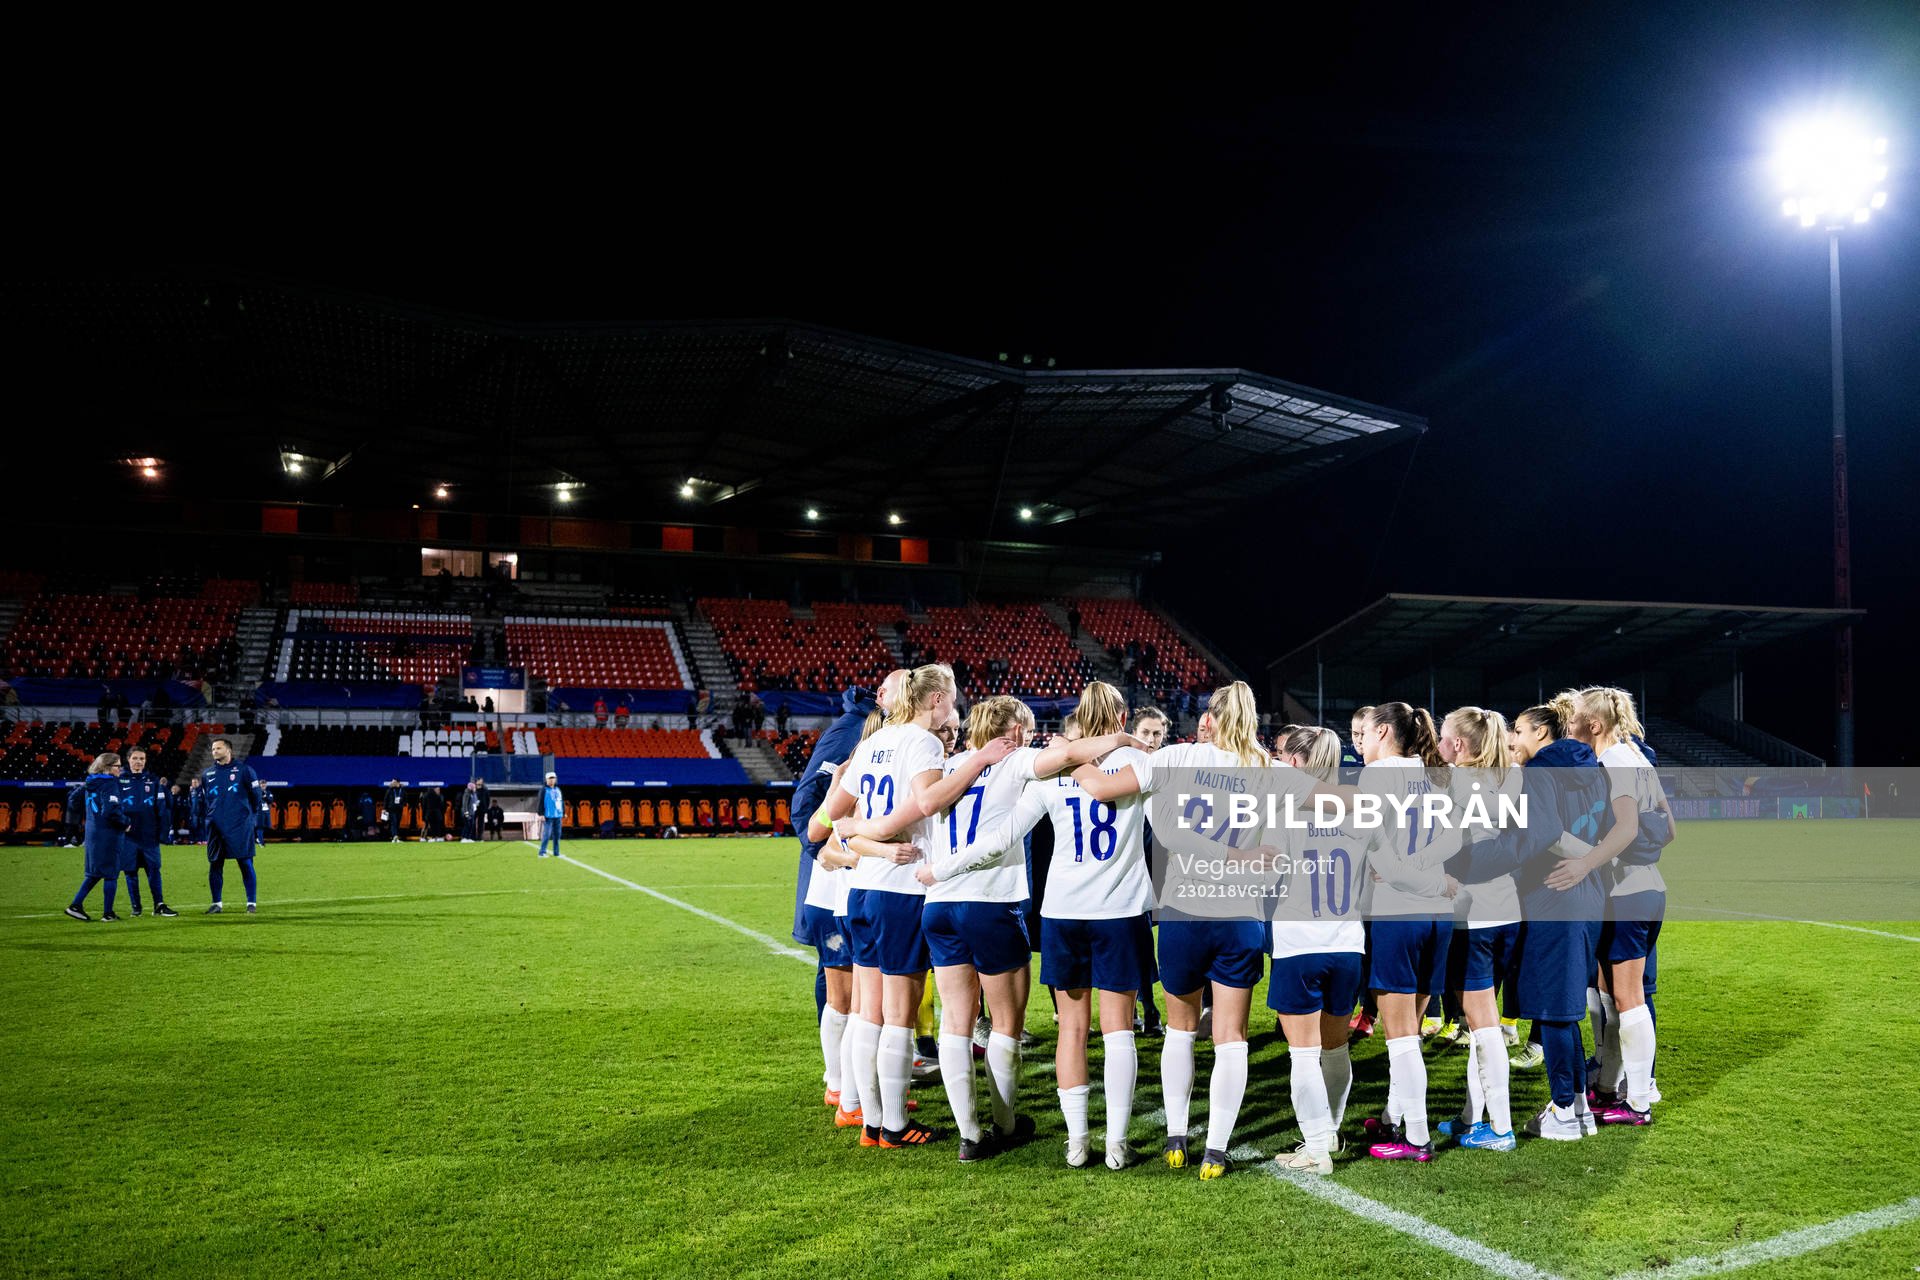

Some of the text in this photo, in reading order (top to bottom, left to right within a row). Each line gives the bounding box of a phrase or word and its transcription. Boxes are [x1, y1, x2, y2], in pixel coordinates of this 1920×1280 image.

[1194, 770, 1246, 793] NAUTNES
[949, 785, 985, 855] 17
[1065, 797, 1118, 862] 18
[1303, 848, 1351, 918] 10
